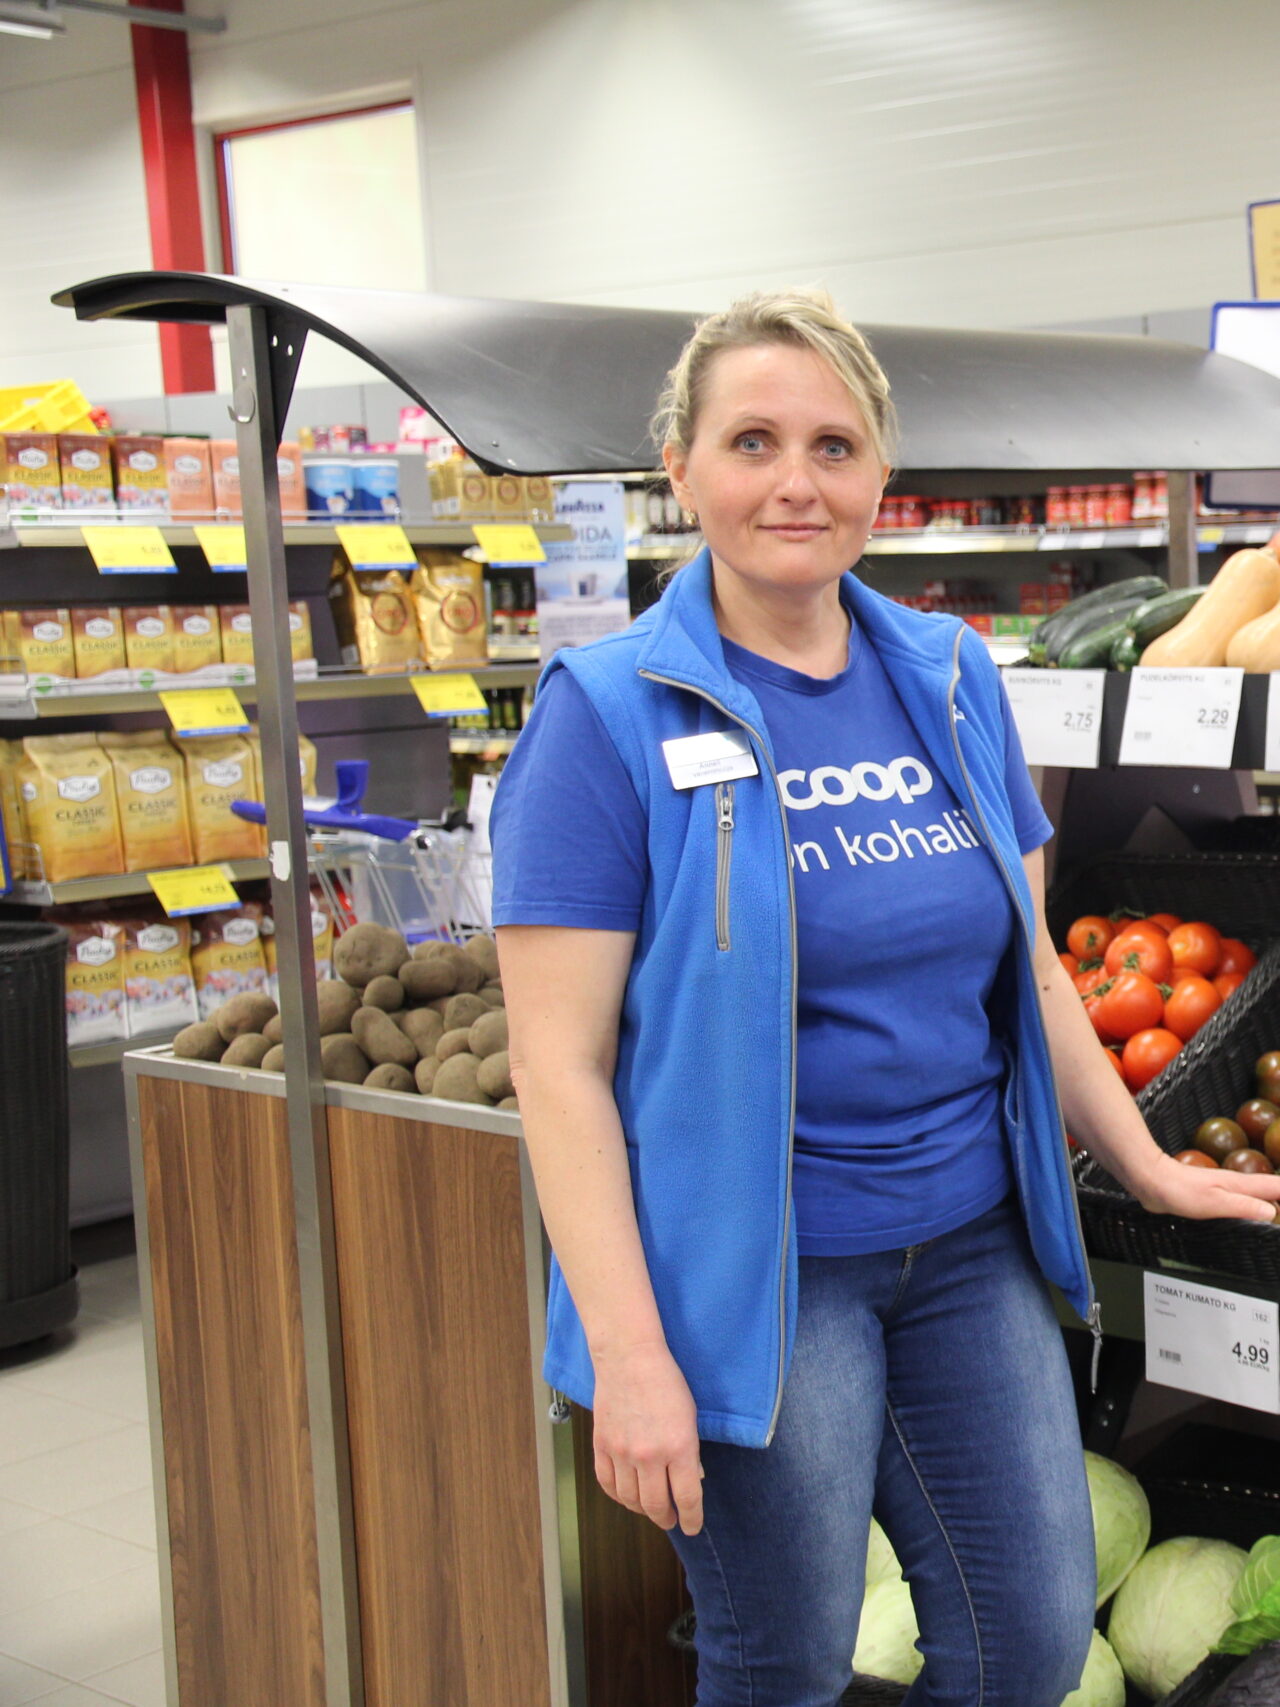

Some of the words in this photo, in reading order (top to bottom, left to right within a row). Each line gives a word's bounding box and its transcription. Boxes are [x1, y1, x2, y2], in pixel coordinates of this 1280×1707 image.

[1064, 711, 1093, 729] 2.75
[1197, 708, 1230, 726] 2.29
[777, 756, 933, 811] coop
[788, 841, 830, 873] n
[1154, 1284, 1184, 1299] TOMAT
[1185, 1291, 1222, 1308] KUMATO
[1223, 1302, 1236, 1311] KG
[1232, 1341, 1269, 1365] 4.99
